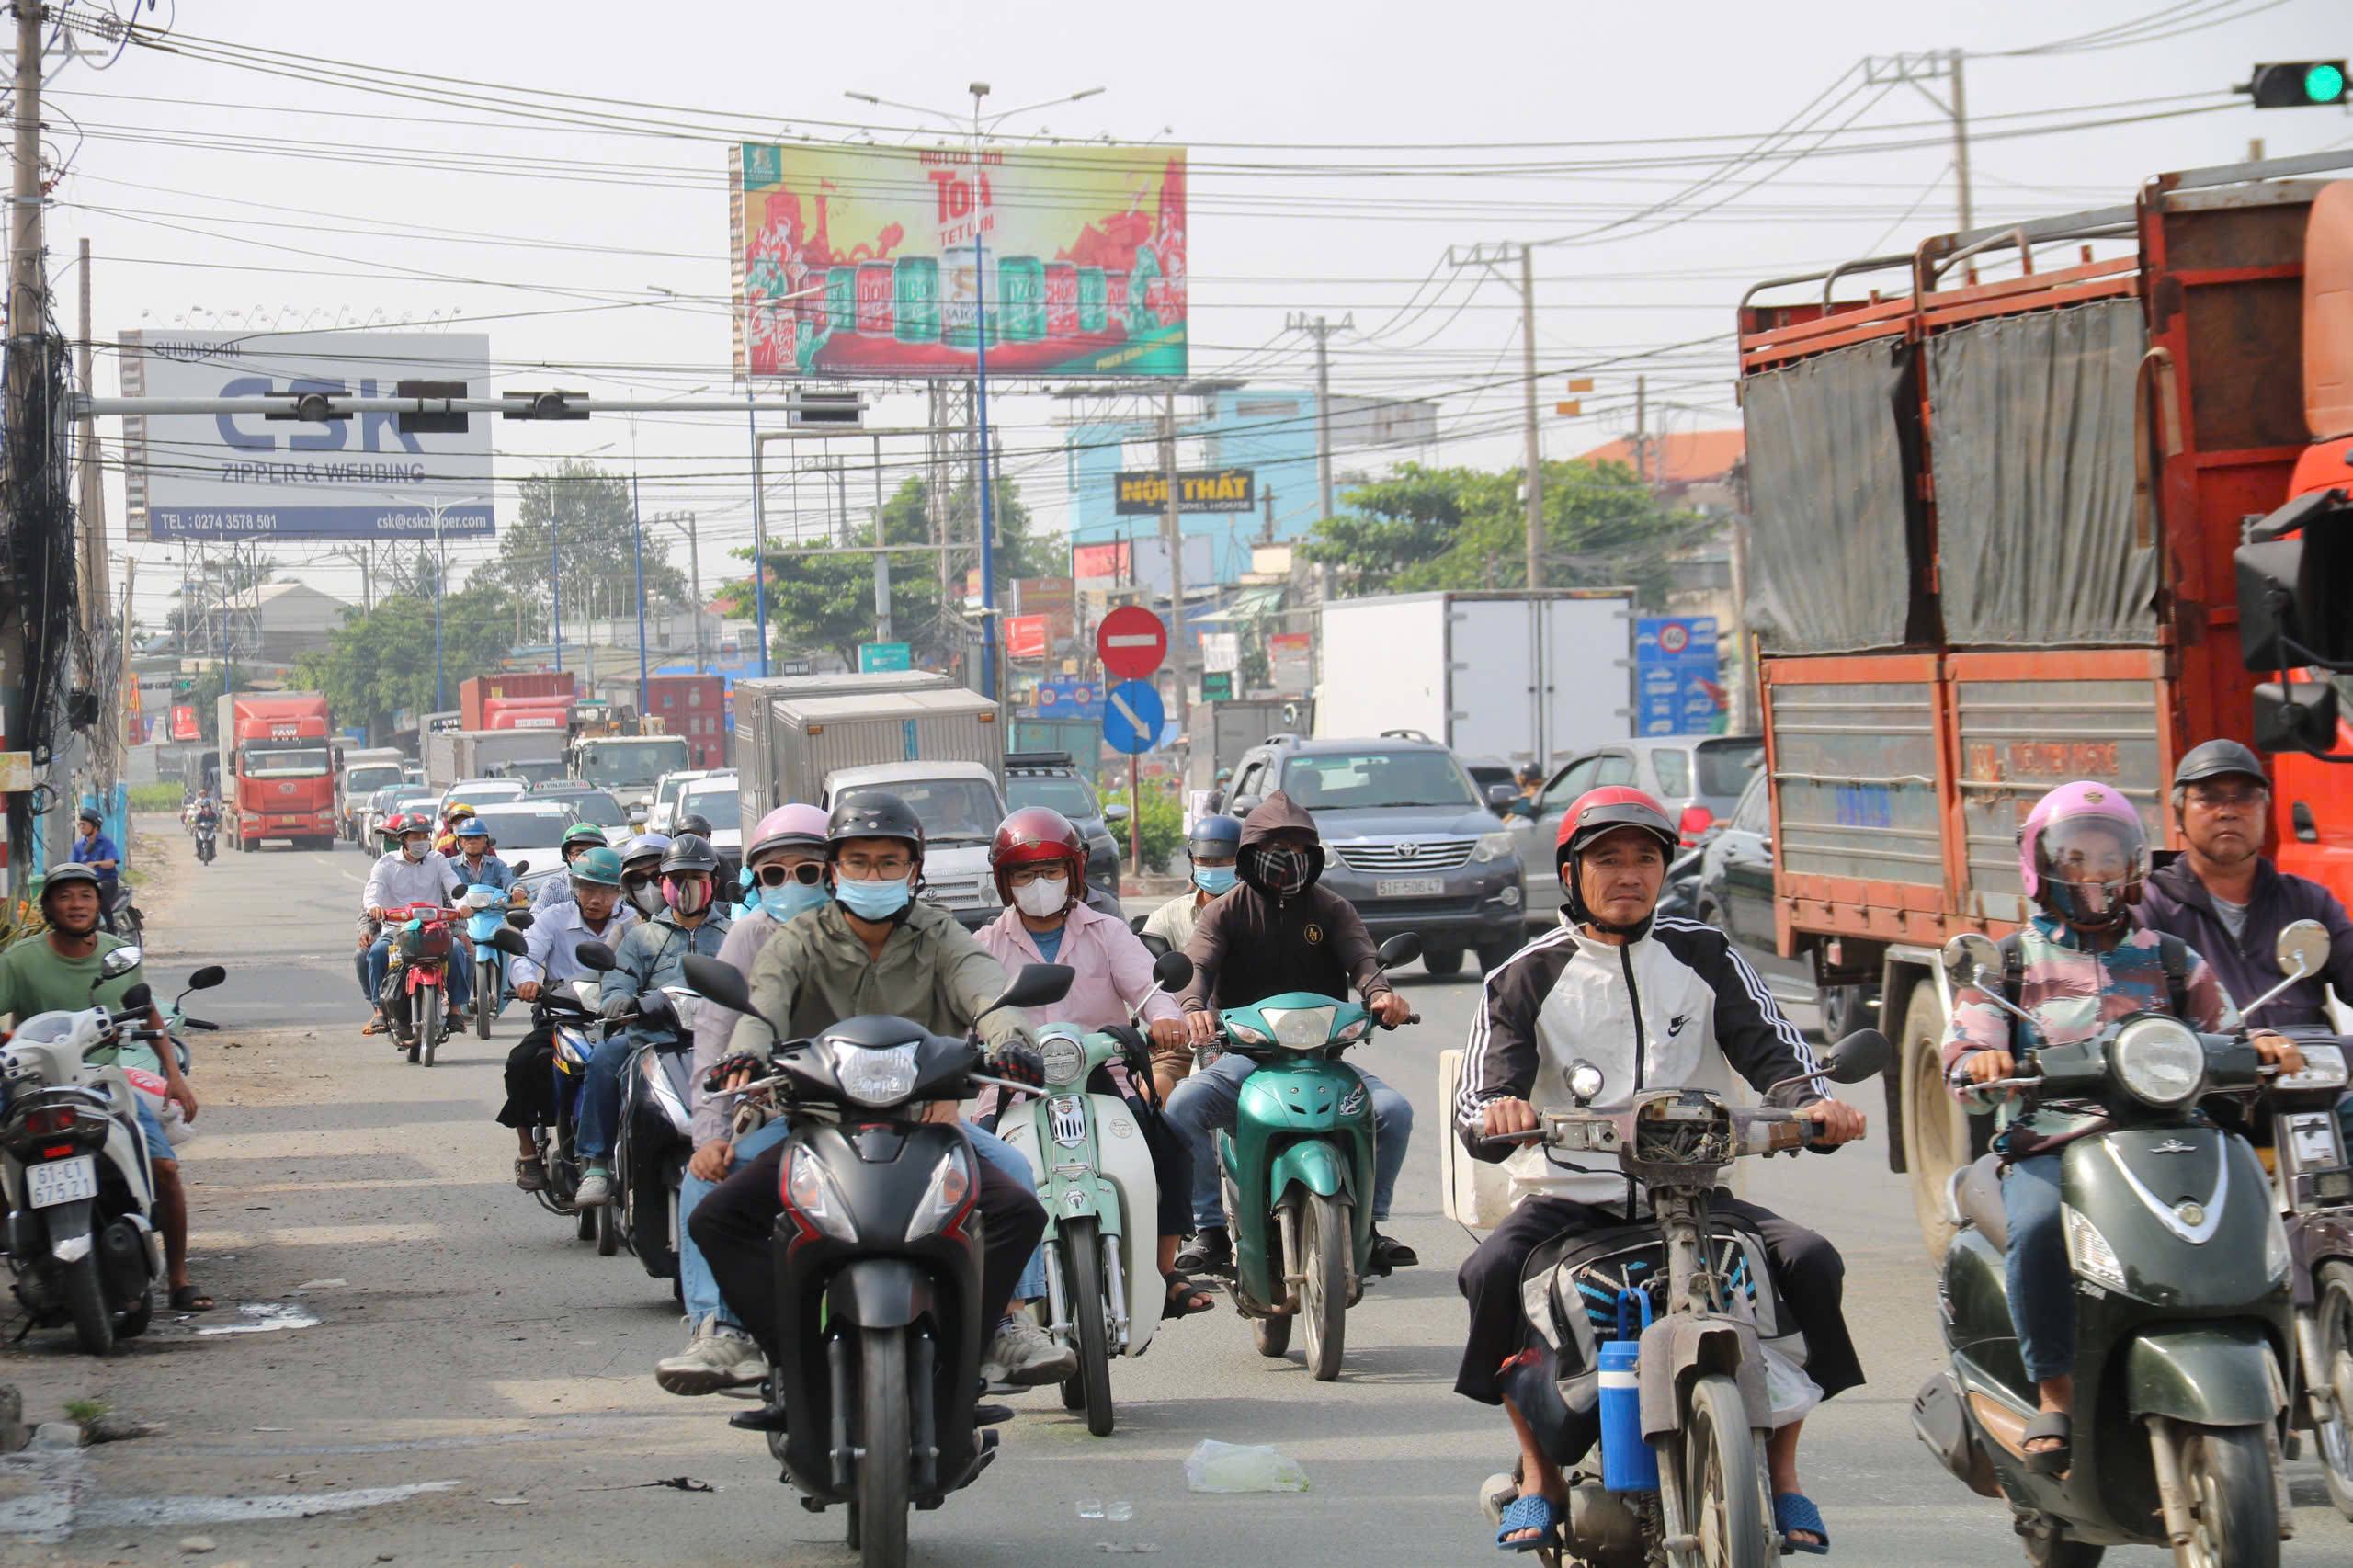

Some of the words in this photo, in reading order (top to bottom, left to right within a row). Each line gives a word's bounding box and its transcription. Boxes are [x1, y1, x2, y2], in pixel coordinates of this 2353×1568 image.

[154, 341, 241, 358] CHUNSHIN
[216, 378, 425, 453] CSK
[221, 463, 298, 483] ZIPPER
[304, 463, 319, 483] &
[325, 463, 425, 483] WEBBING
[161, 514, 185, 529] TEL
[194, 514, 222, 529] 0274
[225, 514, 254, 529] 3578
[256, 514, 277, 529] 501
